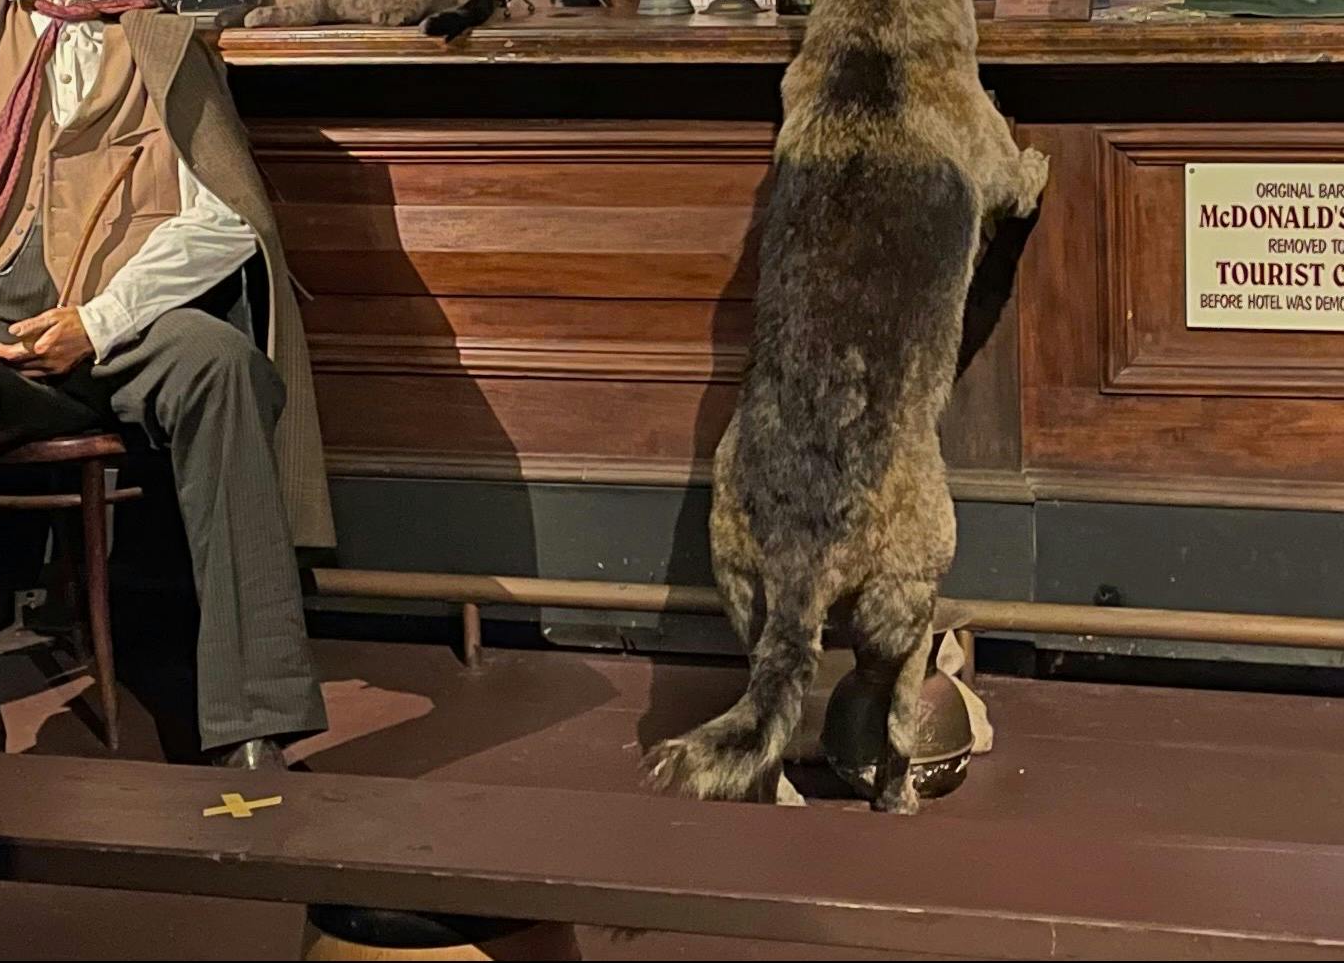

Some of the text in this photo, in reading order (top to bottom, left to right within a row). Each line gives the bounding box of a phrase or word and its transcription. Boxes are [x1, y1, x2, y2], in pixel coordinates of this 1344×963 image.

[1256, 182, 1315, 199] ORIGINAL
[1268, 238, 1327, 254] REMOVED
[1216, 261, 1325, 287] TOURIST
[1200, 294, 1243, 310] BEFORE
[1248, 294, 1283, 311] HOTEL
[1286, 295, 1312, 311] WAS
